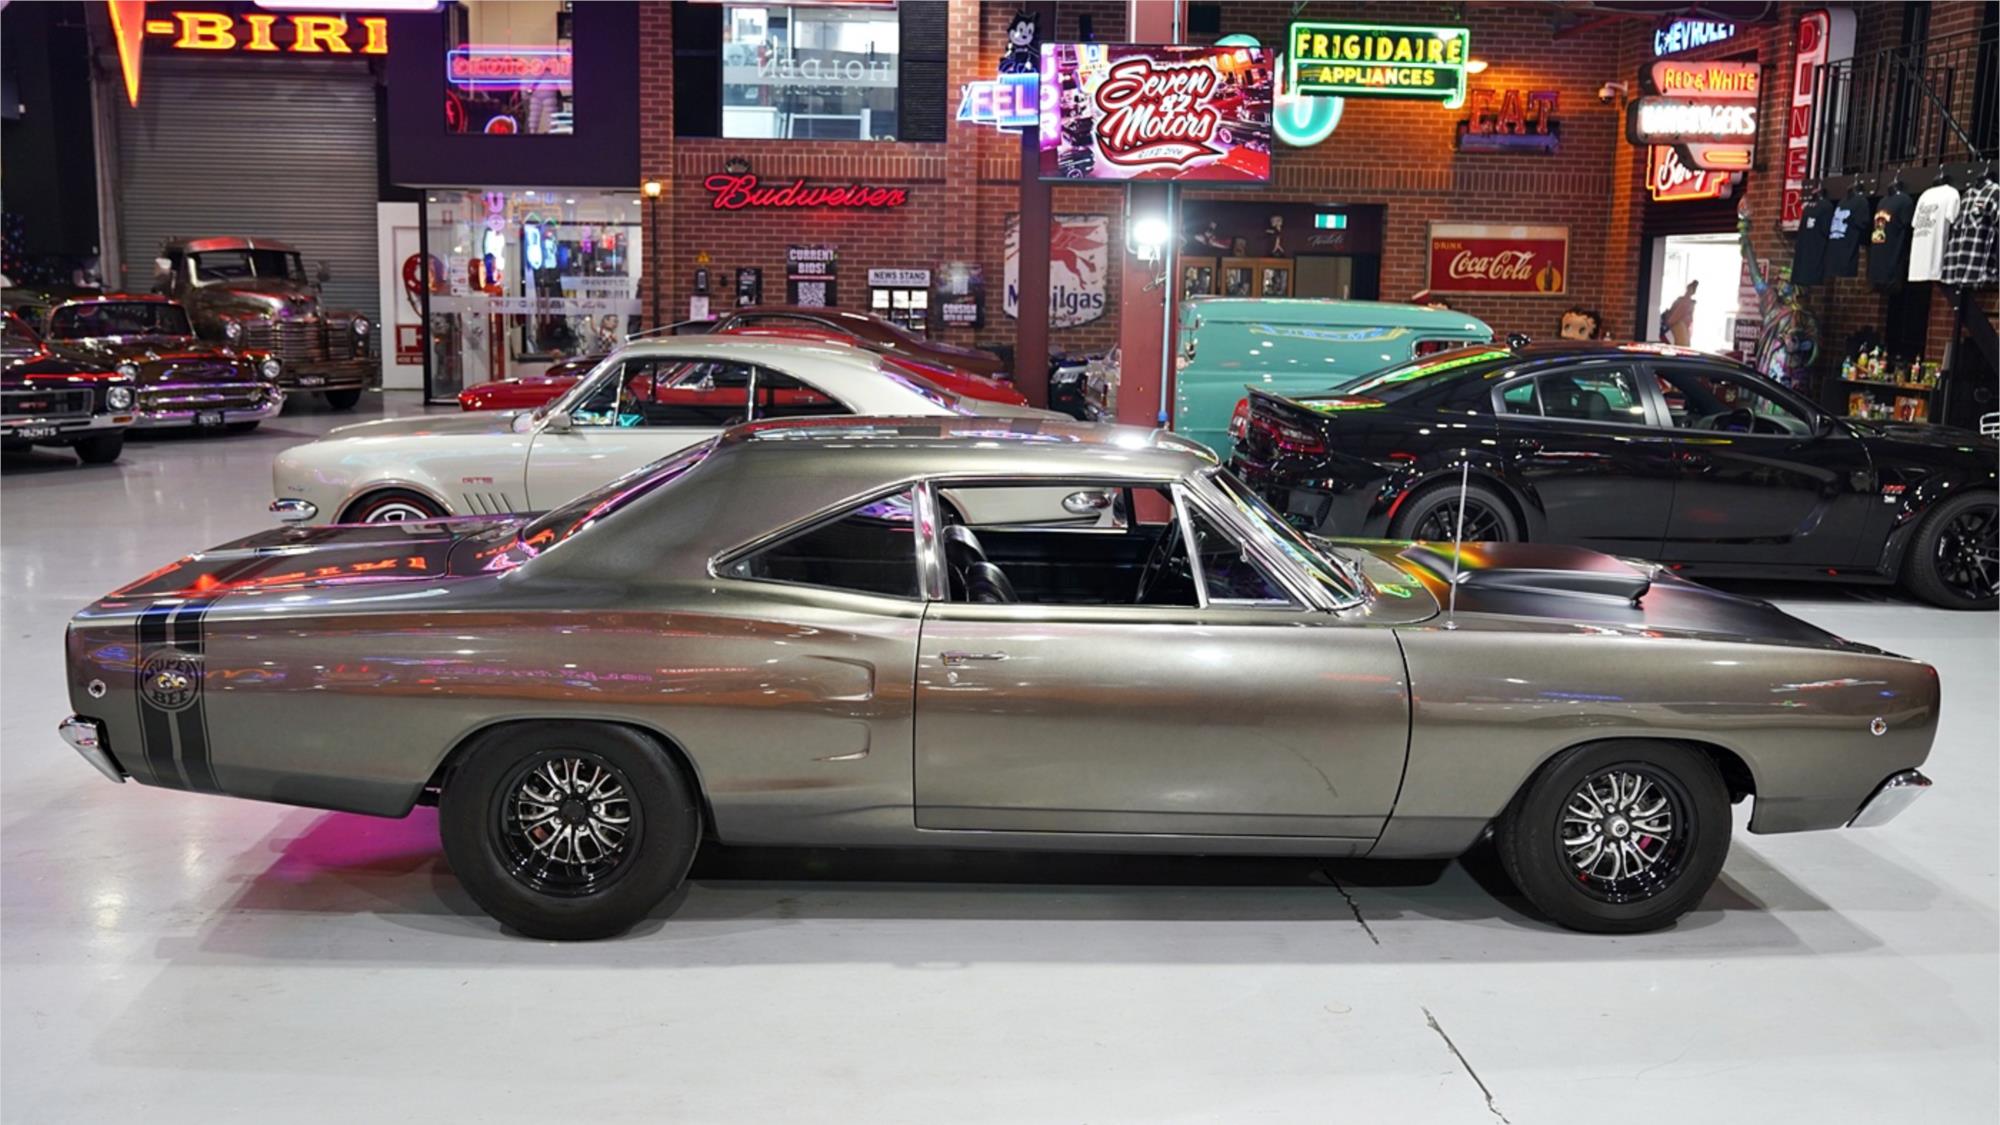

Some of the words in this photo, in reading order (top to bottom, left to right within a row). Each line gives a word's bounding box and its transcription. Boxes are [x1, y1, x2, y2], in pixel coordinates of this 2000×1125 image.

[1296, 33, 1463, 63] FRIGIDAIRE
[1101, 63, 1209, 109] Seven
[1319, 66, 1436, 86] APPLIANCES
[1664, 67, 1692, 88] RED
[1706, 68, 1755, 92] WHITE
[1102, 103, 1212, 149] Motors
[1469, 88, 1561, 135] EAT
[1783, 20, 1818, 218] DINER
[704, 173, 906, 209] Budweiser
[789, 248, 834, 261] CURRENT
[1434, 241, 1463, 250] DRINK
[873, 271, 897, 280] NEWS
[899, 271, 926, 280] STAND
[1449, 249, 1537, 280] Coca-Cola
[1008, 284, 1104, 315] Milgas
[145, 658, 197, 681] SUPER
[152, 690, 189, 705] BEE
